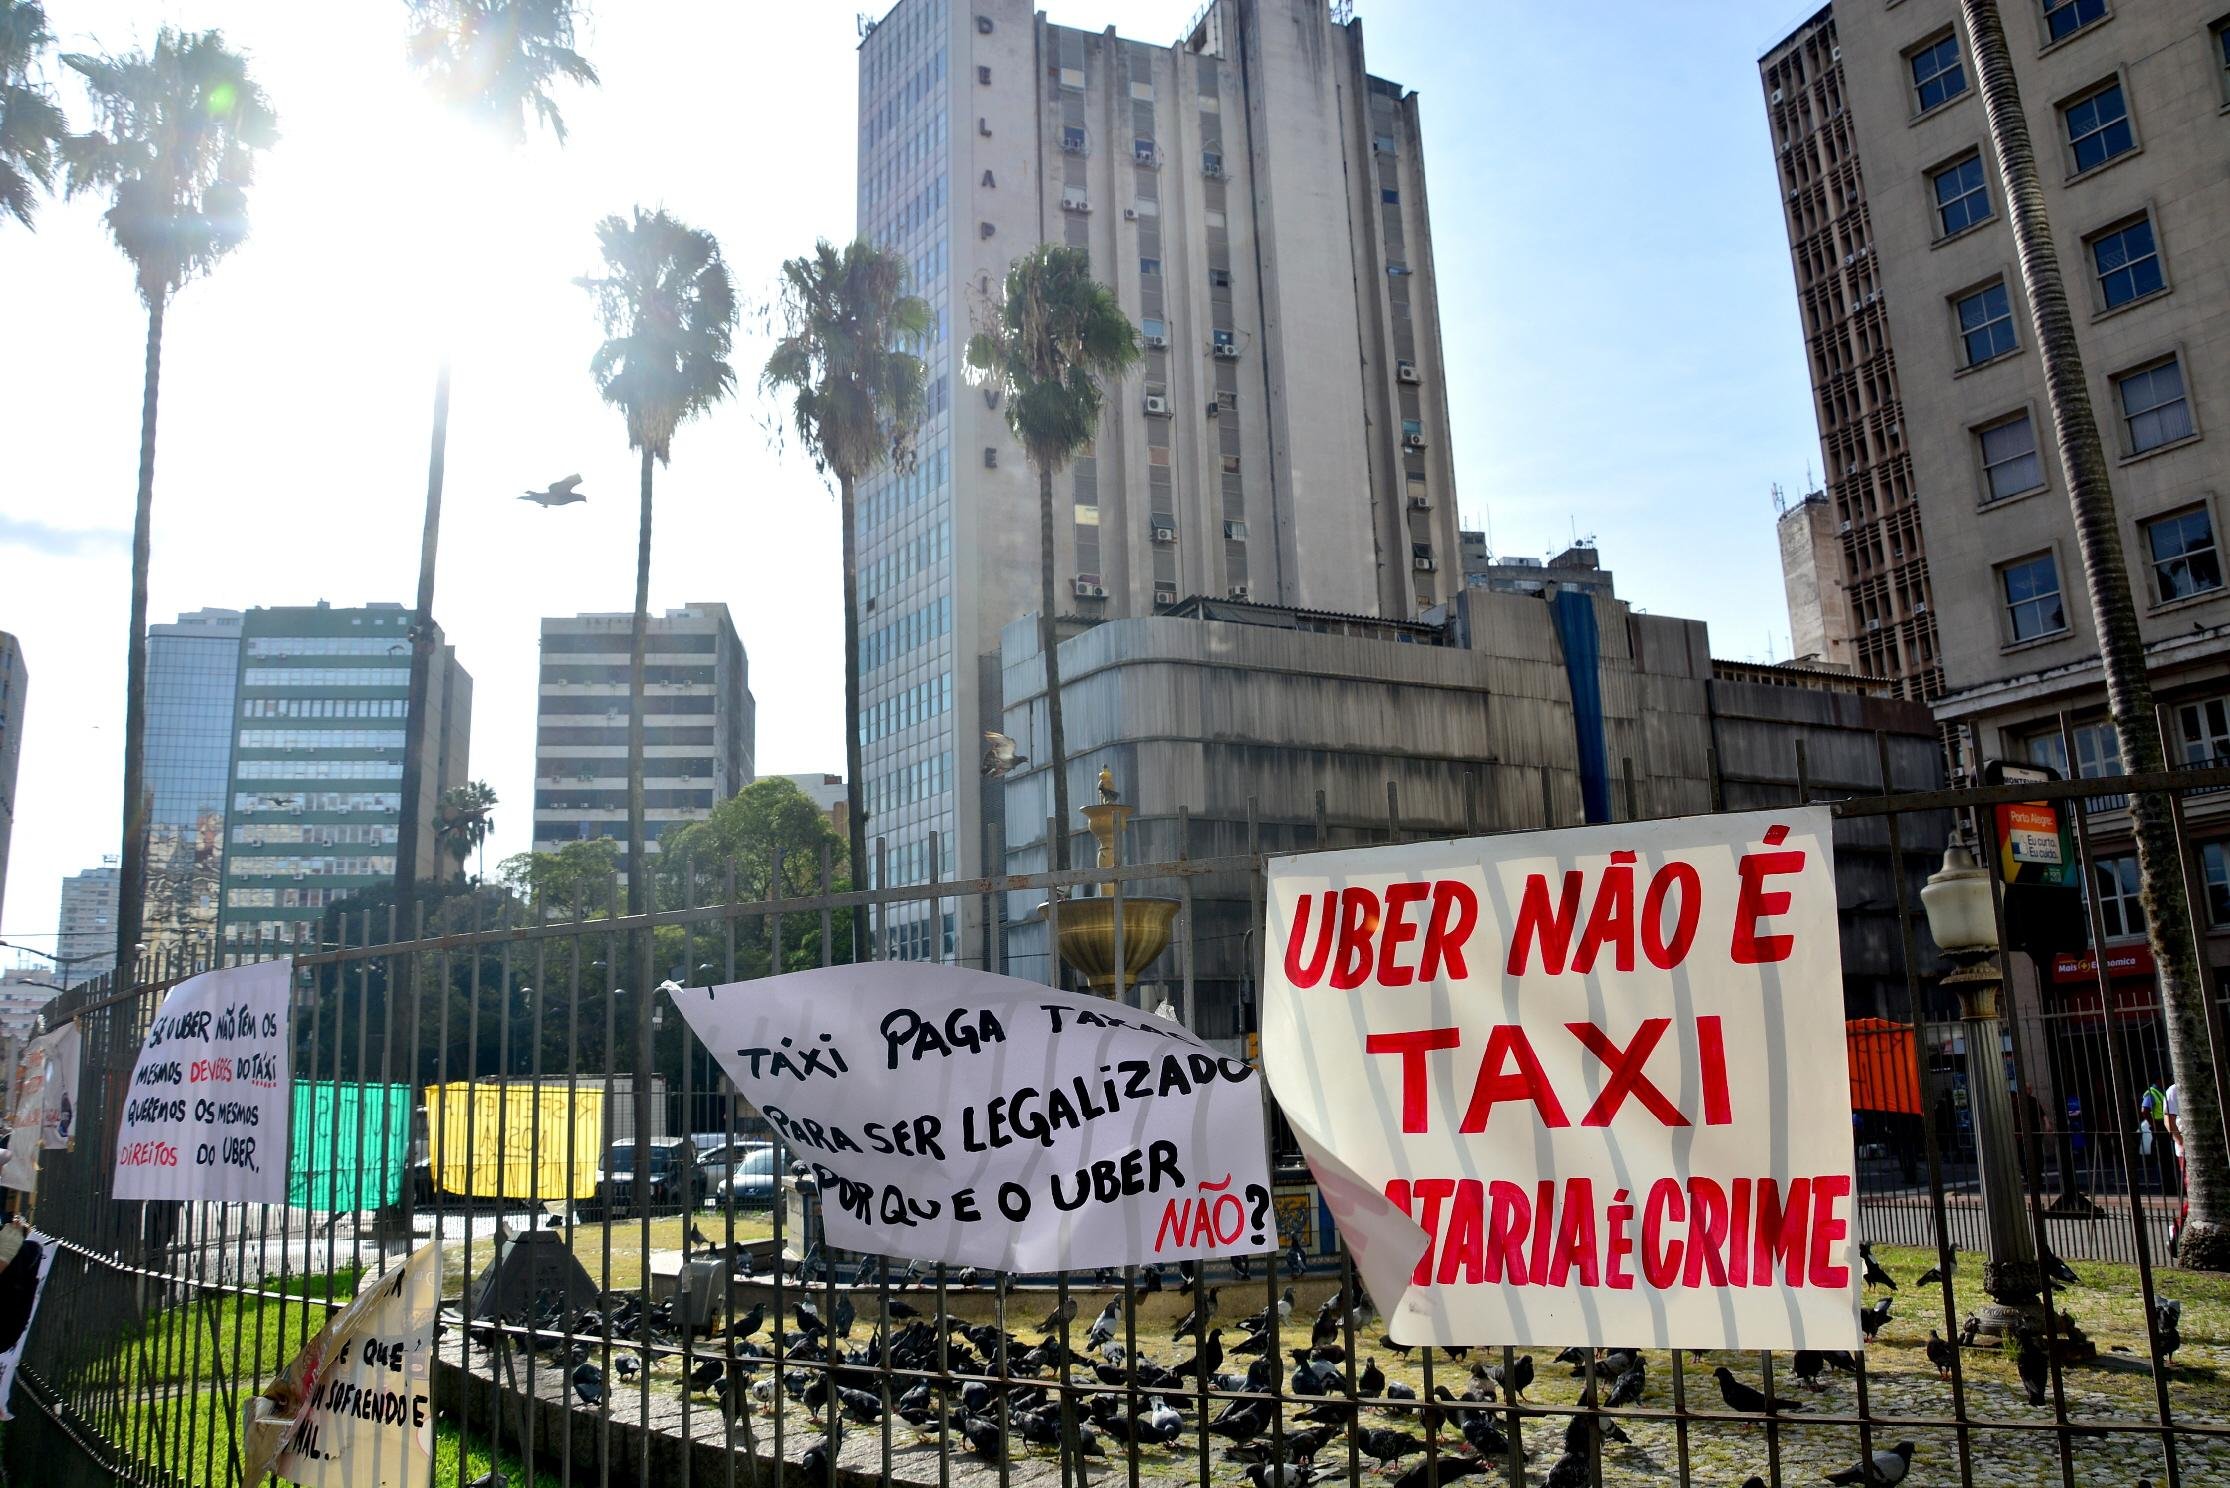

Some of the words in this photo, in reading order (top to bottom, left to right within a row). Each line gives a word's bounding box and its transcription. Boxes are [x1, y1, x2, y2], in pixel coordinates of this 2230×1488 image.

[976, 15, 1000, 469] DELAPIVE
[2010, 810, 2029, 823] Porto
[2027, 834, 2036, 846] Eu
[2029, 846, 2038, 858] Eu
[1284, 879, 1479, 991] UBER
[1507, 849, 1703, 977] NÃO
[1731, 824, 1806, 965] É
[2058, 964, 2078, 973] Mais
[150, 1016, 167, 1048] SE
[167, 1017, 175, 1040] O
[176, 1010, 212, 1043] UBER
[215, 1002, 236, 1041] NÃO
[238, 1003, 256, 1040] TEM
[262, 1012, 277, 1039] OS
[880, 1007, 1006, 1070] PAGA
[136, 1060, 182, 1086] MESMOS
[237, 1057, 250, 1081] DO
[1366, 1015, 1733, 1135] TAXI
[128, 1096, 186, 1127] QUEREMOS
[195, 1098, 215, 1124] OS
[218, 1101, 259, 1127] MESMOS
[763, 1104, 864, 1154] PARA
[863, 1114, 946, 1161] SER
[196, 1143, 215, 1166] DO
[998, 1182, 1031, 1222] O
[1051, 1140, 1185, 1211] UBER
[1606, 1190, 1634, 1290] É
[1641, 1175, 1851, 1290] CRIME
[363, 1338, 404, 1372] QUE
[325, 1379, 408, 1427] SOFRENDO
[412, 1395, 428, 1428] E
